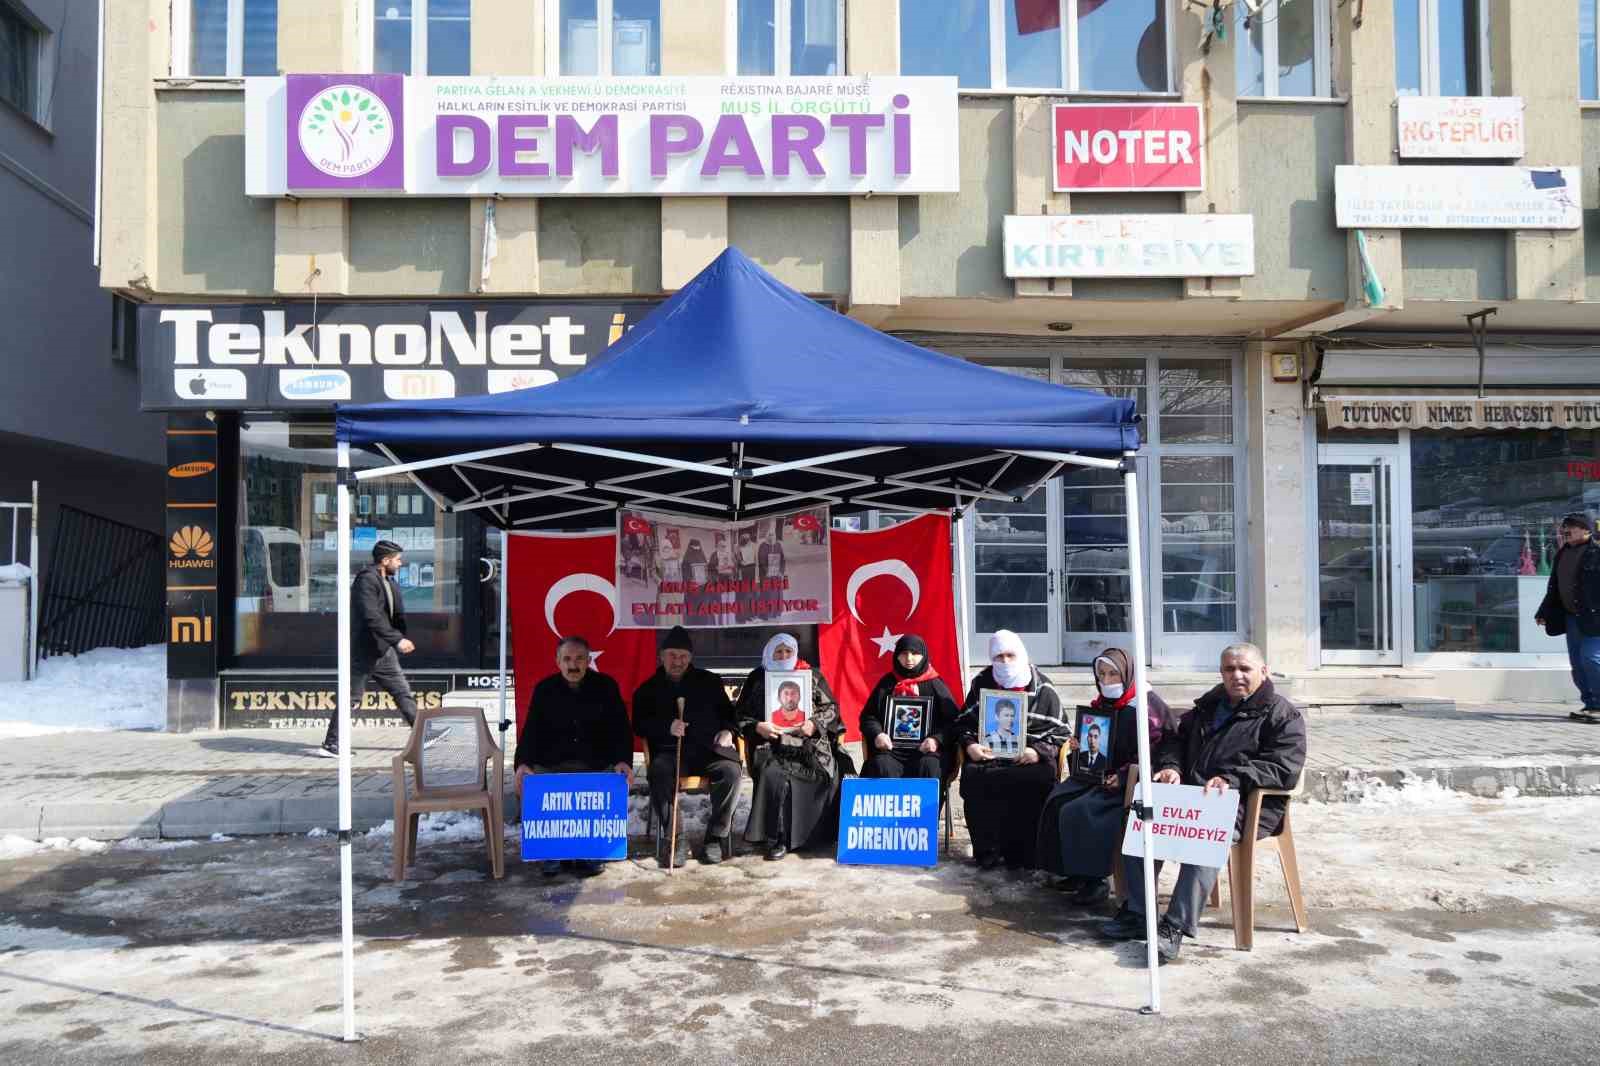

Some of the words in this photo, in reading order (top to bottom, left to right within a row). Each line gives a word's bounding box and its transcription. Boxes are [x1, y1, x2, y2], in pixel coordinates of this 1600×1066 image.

[438, 102, 504, 112] HALKLARIN
[554, 102, 567, 112] VE
[571, 100, 637, 112] DEMOKRASİ
[436, 115, 619, 177] DEM
[651, 94, 911, 177] PARTİ
[1064, 129, 1194, 165] NOTER
[160, 309, 588, 366] TeknoNet
[1343, 403, 1412, 422] TÜTÜNCÜ
[1428, 403, 1473, 422] NİMET
[169, 559, 214, 568] HUAWEI
[541, 792, 573, 811] ARTIK
[575, 791, 604, 810] YETER
[851, 794, 922, 818] ANNELER
[1162, 806, 1202, 820] EVLAT
[523, 820, 591, 839] YAKAMIZDAN
[593, 814, 627, 843] DÜŞÜN
[847, 821, 929, 851] DİRENİYOR
[1132, 820, 1227, 842] NBETİNDEYİZ
